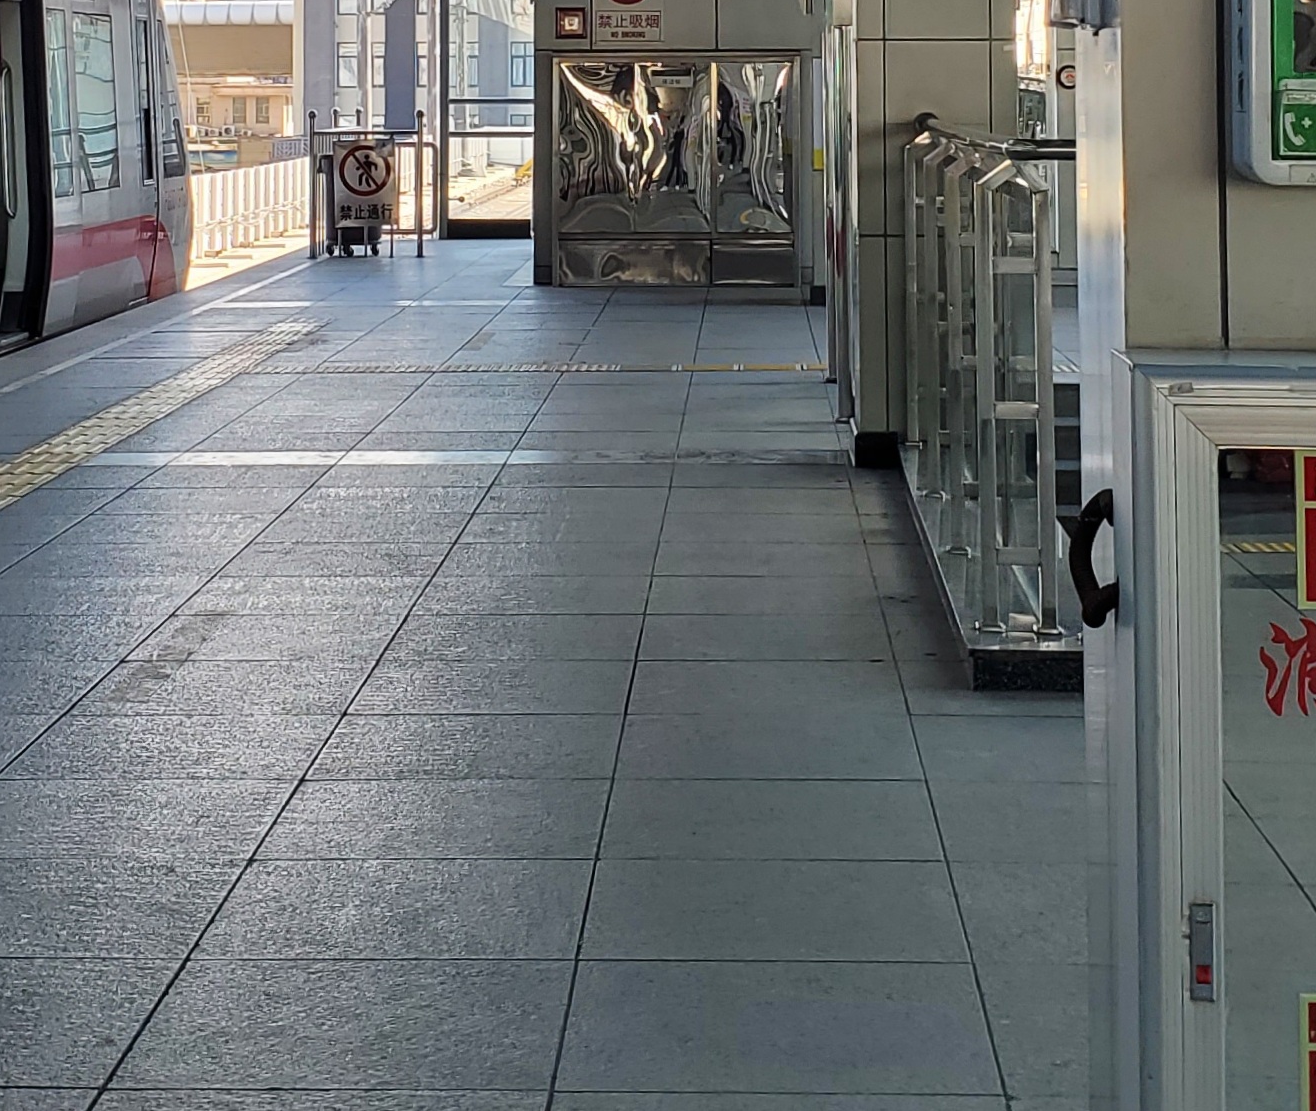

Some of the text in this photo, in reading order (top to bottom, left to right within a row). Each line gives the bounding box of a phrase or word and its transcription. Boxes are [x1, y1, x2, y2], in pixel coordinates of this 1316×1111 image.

[598, 14, 660, 29] 禁止吸烟
[339, 203, 394, 221] 禁止通行
